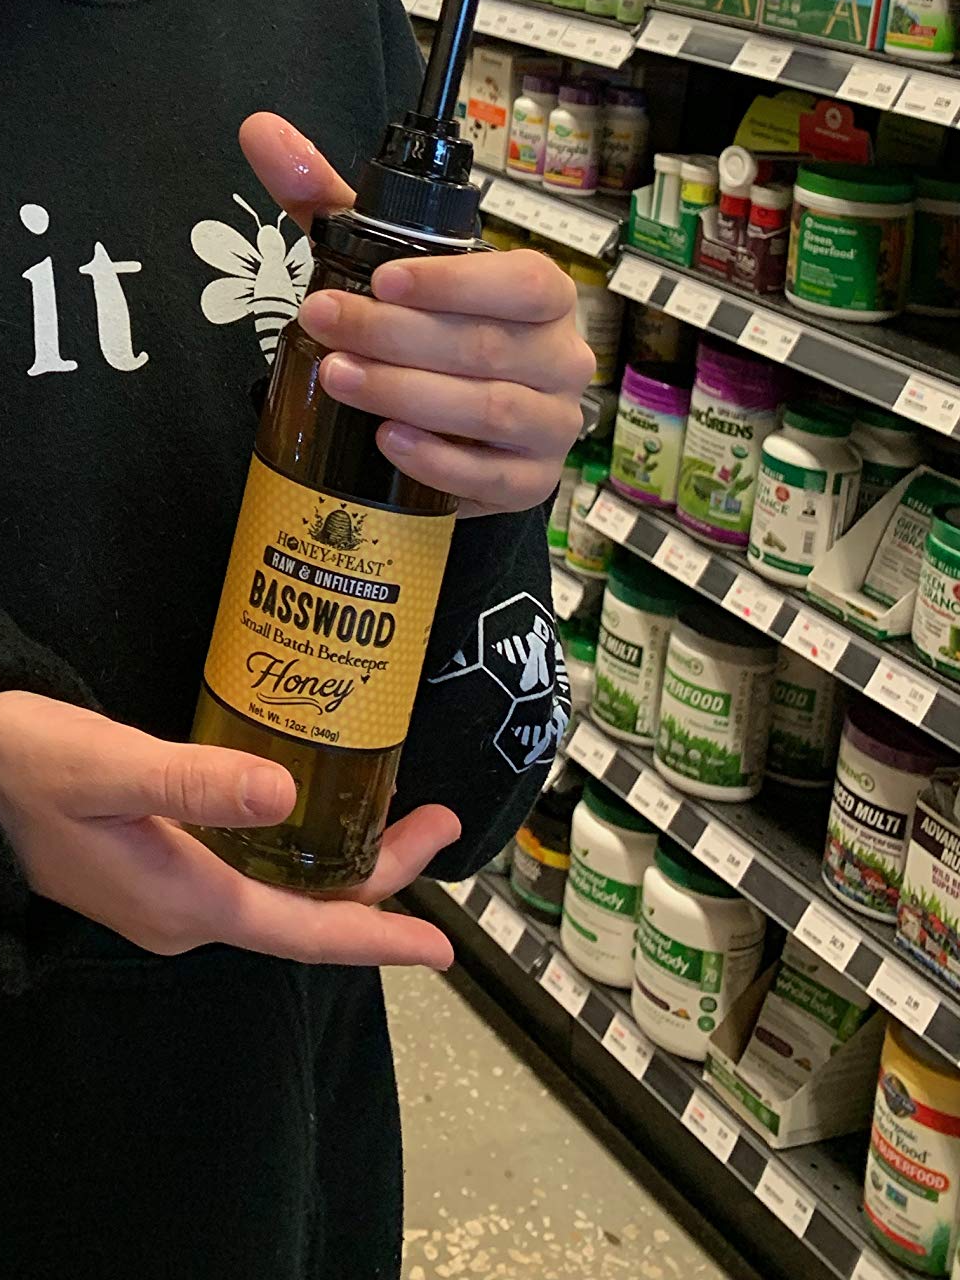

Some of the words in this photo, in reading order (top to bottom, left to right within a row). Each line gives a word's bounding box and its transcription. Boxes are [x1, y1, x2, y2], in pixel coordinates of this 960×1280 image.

[802, 238, 856, 261] Superfood
[803, 229, 833, 246] Green
[18, 203, 150, 376] it
[271, 551, 296, 573] RAW
[298, 565, 312, 580] &
[313, 569, 390, 602] UNFILTERED
[333, 552, 386, 577] FEAST
[247, 569, 397, 649] BASSWOOD
[239, 609, 271, 639] Small
[272, 627, 315, 658] Batch
[317, 643, 390, 673] Beekeeper
[608, 636, 640, 663] MULTI
[245, 650, 356, 713] Honey
[669, 677, 725, 714] ERFOOD
[267, 710, 282, 726] Wt.
[309, 724, 341, 743] (340g)
[854, 800, 902, 835] MULTI
[920, 815, 960, 852] ADVANC
[895, 1133, 928, 1164] Food
